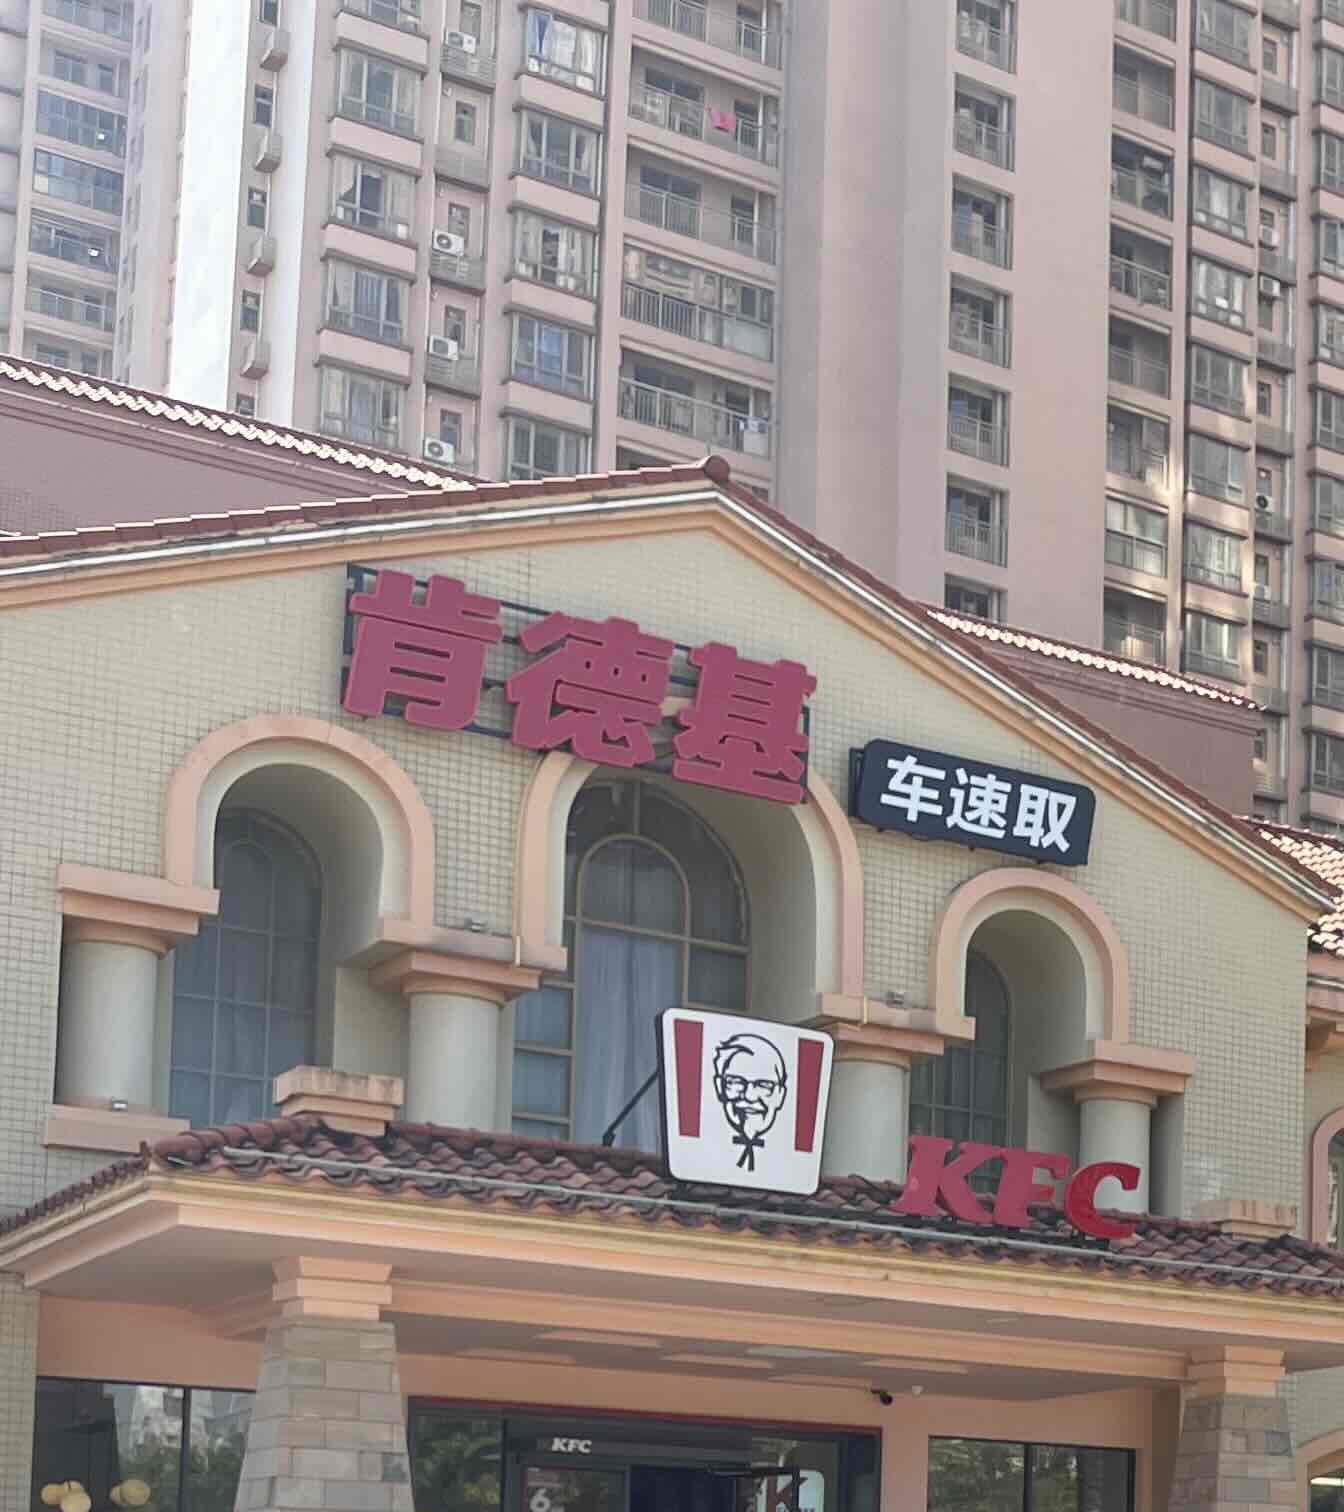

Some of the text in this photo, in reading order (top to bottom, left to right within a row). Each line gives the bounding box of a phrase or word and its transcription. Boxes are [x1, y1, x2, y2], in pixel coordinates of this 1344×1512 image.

[343, 569, 816, 804] 肯德基
[880, 755, 1077, 853] 车速取
[888, 1135, 1141, 1240] KFC
[551, 1437, 592, 1454] KFC
